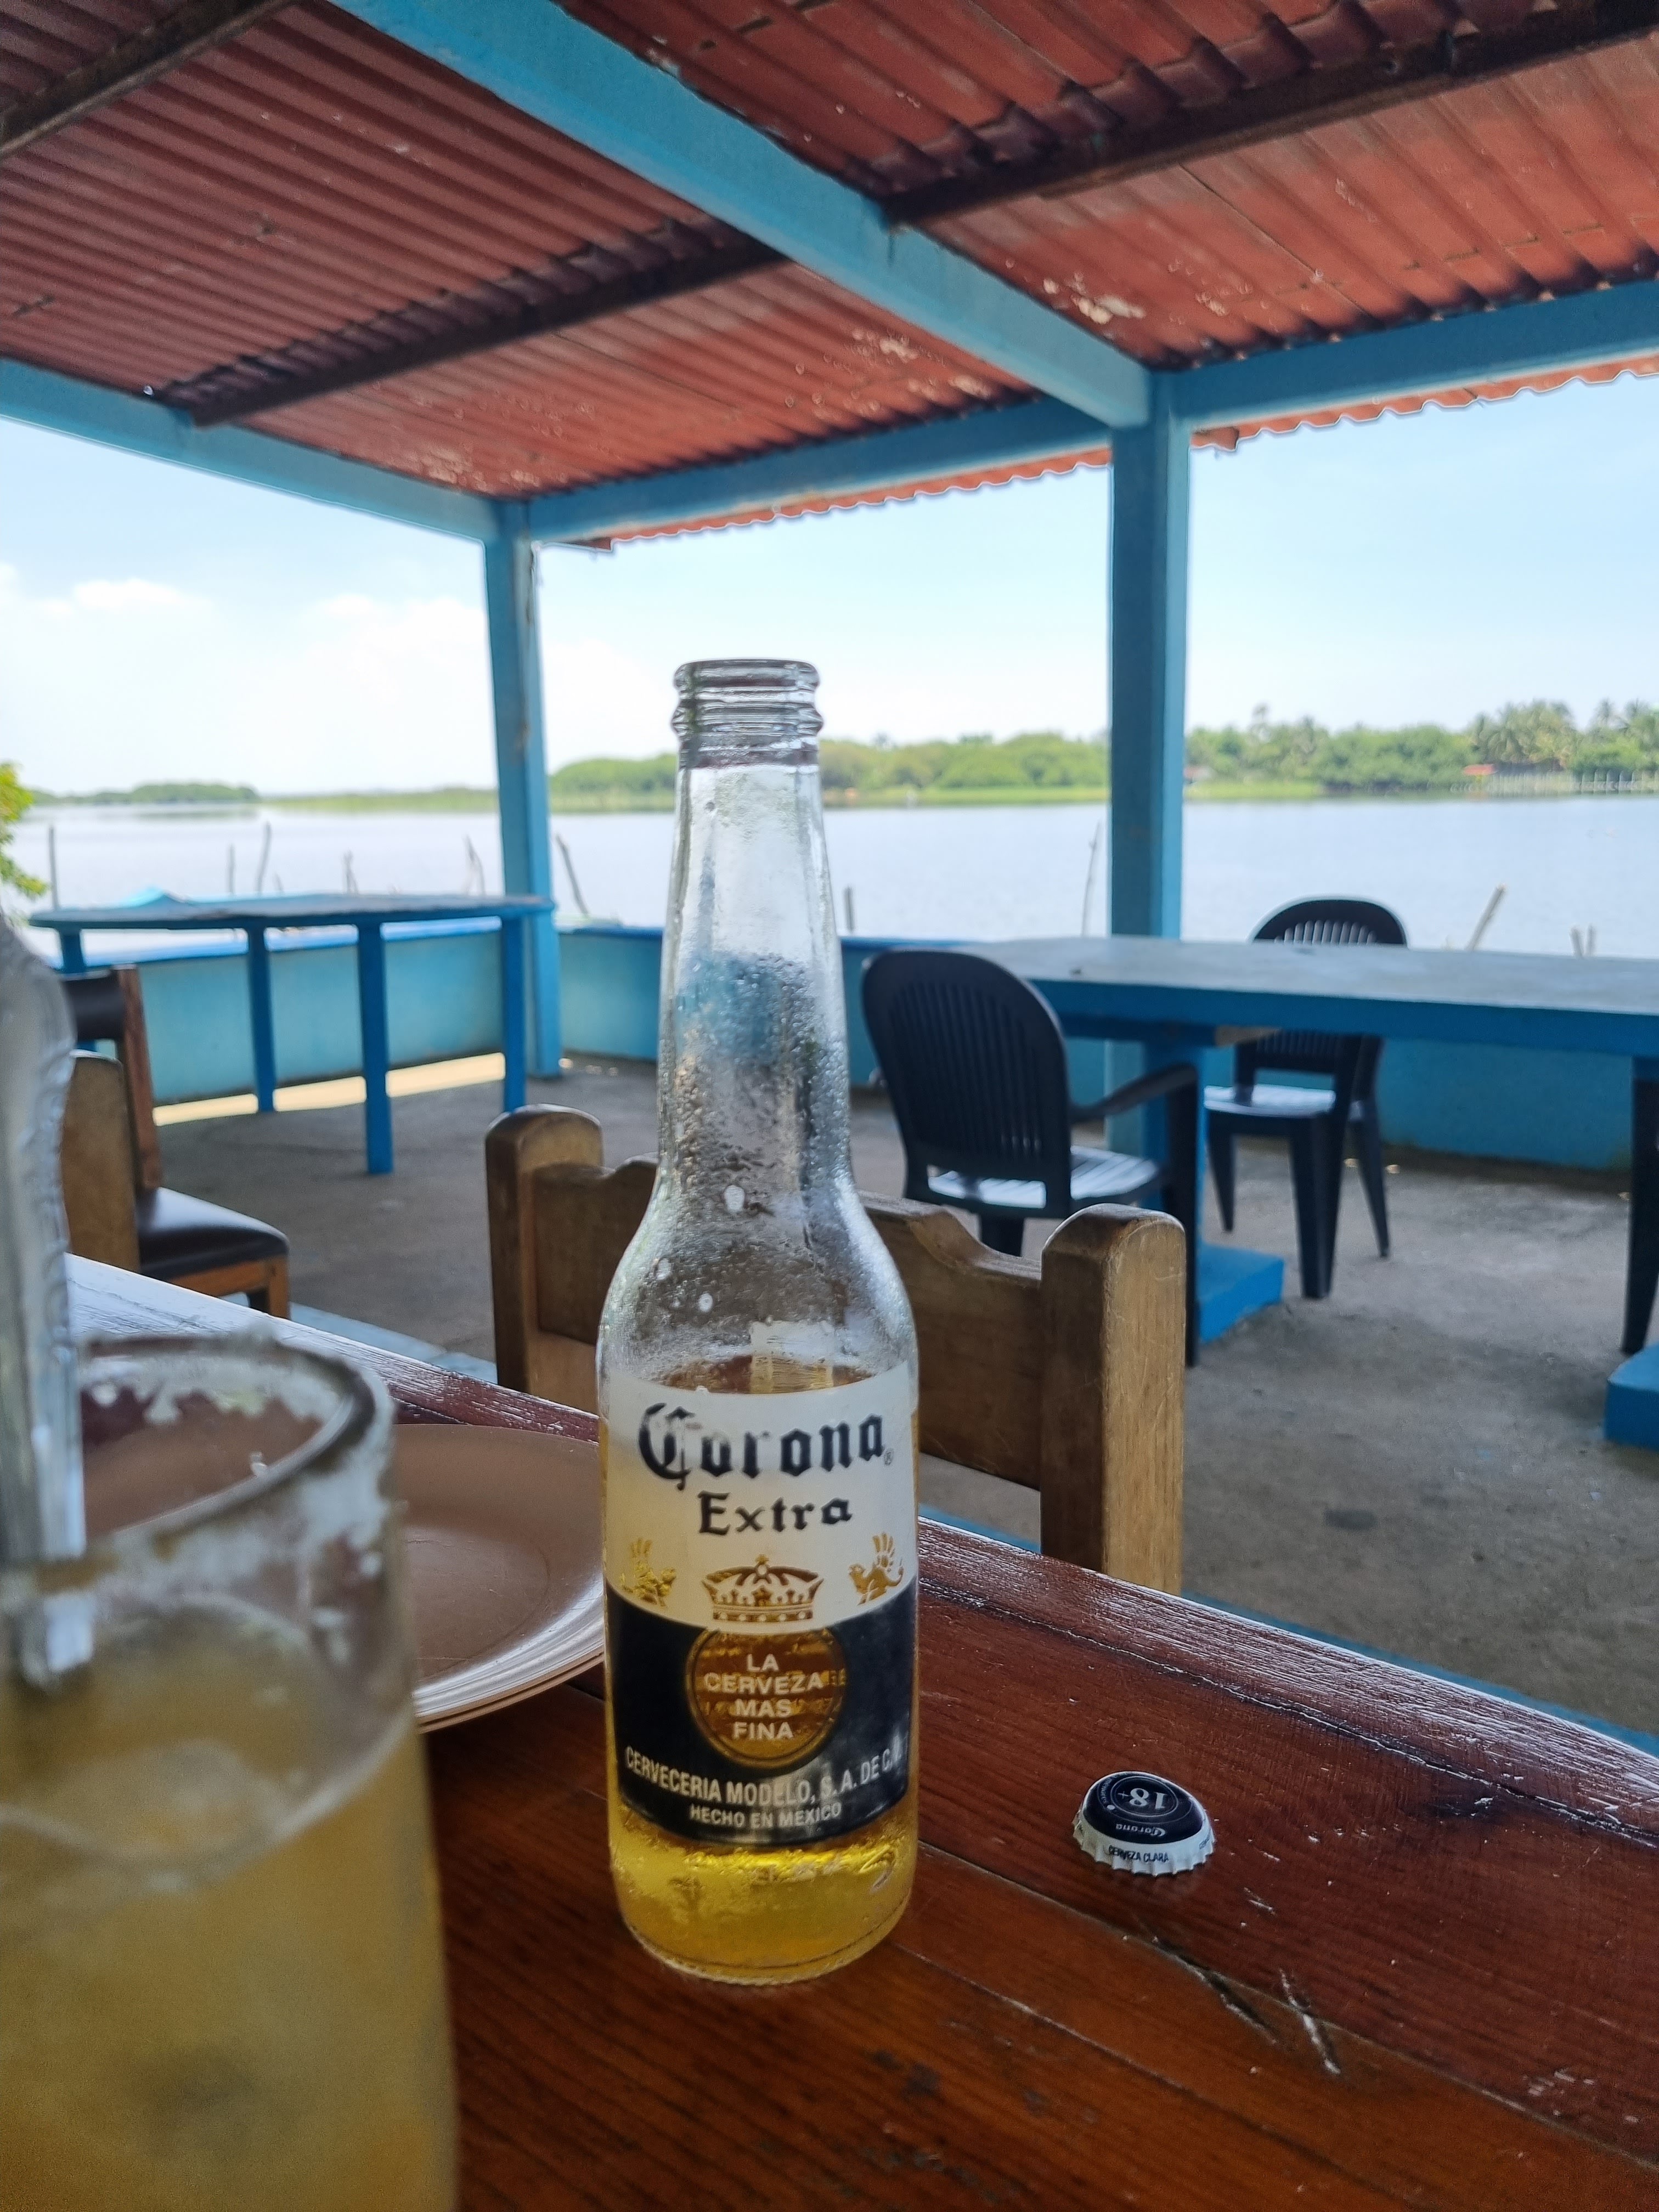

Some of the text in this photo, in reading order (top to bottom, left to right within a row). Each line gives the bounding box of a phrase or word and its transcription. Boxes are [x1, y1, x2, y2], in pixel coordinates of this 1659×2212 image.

[637, 1402, 885, 1491] Corona
[698, 1490, 853, 1536] Extra
[746, 1653, 779, 1673] LA
[703, 1672, 823, 1695] CERVEZA
[731, 1721, 794, 1740] FINA
[625, 1745, 722, 1803] CERVECERIA
[860, 1755, 881, 1785] DE
[690, 1802, 842, 1829] HECHO EN MEXICO
[1115, 1823, 1166, 1837] Corona
[1108, 1844, 1169, 1863] CERVEZA CLARA
